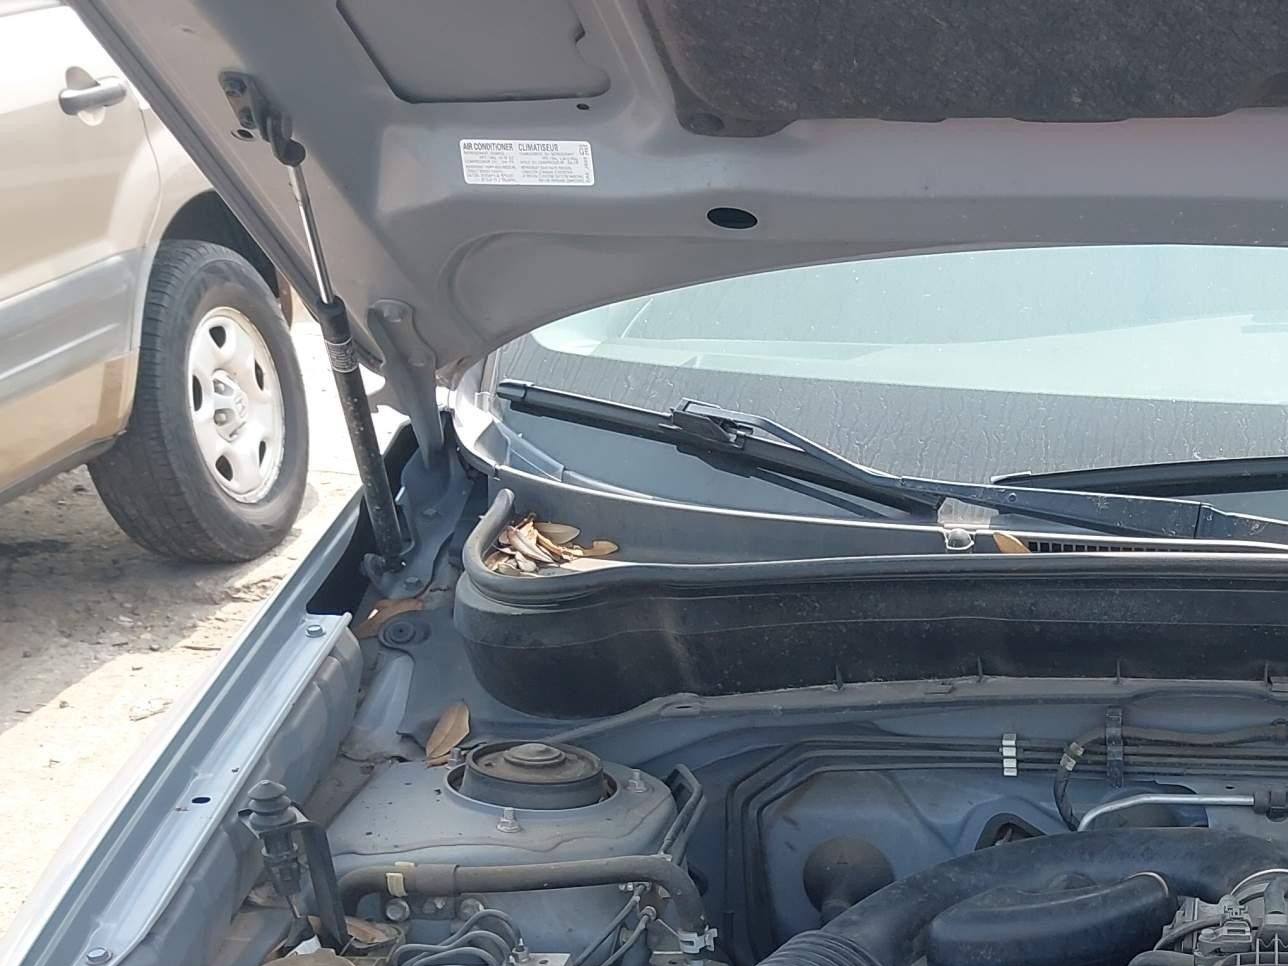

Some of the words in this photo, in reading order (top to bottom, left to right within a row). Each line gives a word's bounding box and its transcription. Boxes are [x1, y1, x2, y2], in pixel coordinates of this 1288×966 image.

[463, 142, 473, 150] AIR
[473, 143, 514, 151] CONDITIONER
[518, 143, 559, 151] CLIMATISEUR
